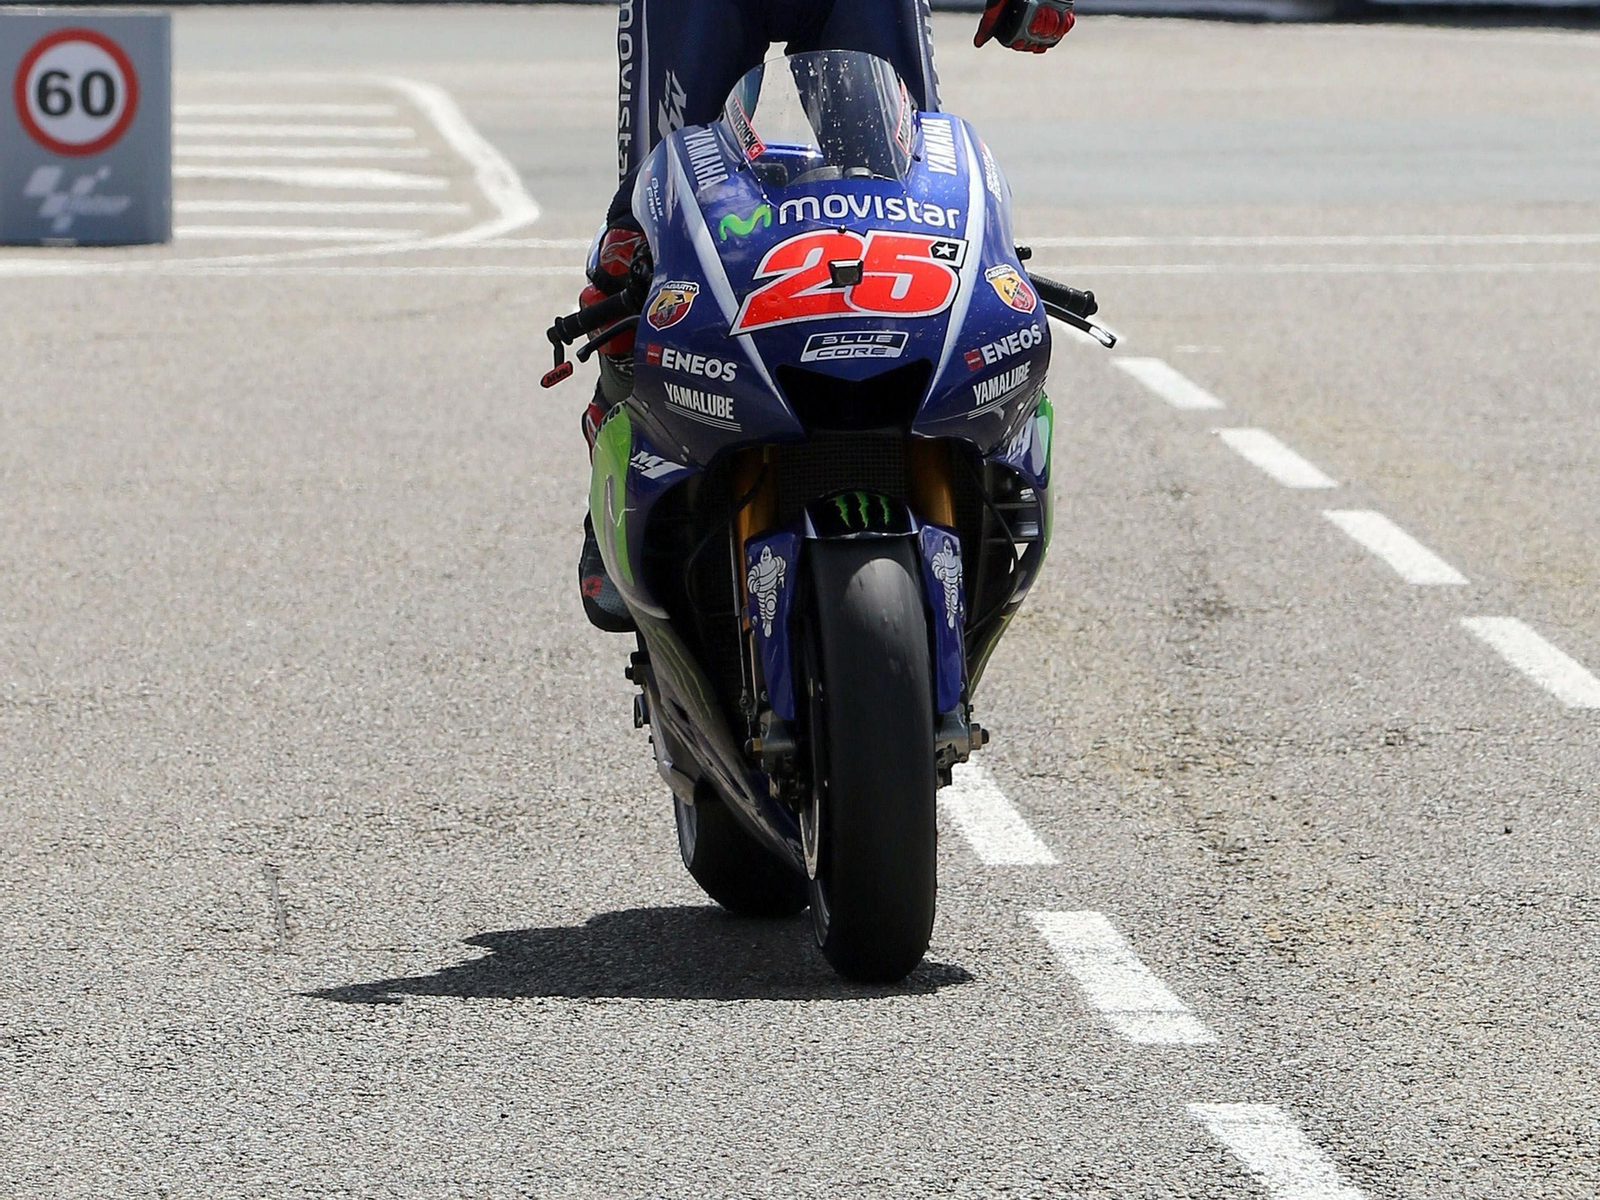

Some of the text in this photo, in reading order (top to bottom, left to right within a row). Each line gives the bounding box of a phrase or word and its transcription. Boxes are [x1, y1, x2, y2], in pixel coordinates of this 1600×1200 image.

[37, 69, 116, 118] 60
[730, 97, 759, 152] MAVERICK
[683, 127, 729, 191] YAMAHA
[921, 118, 957, 175] YAMAHA
[779, 194, 960, 229] movistar
[663, 283, 697, 292] ABARTH
[730, 229, 968, 336] 25
[816, 347, 888, 357] CORE
[822, 334, 893, 345] BLUE
[981, 324, 1042, 365] ENEOS
[661, 348, 738, 382] ENEOS
[973, 360, 1031, 406] YAMALUBE
[664, 381, 735, 420] YAMALUBE
